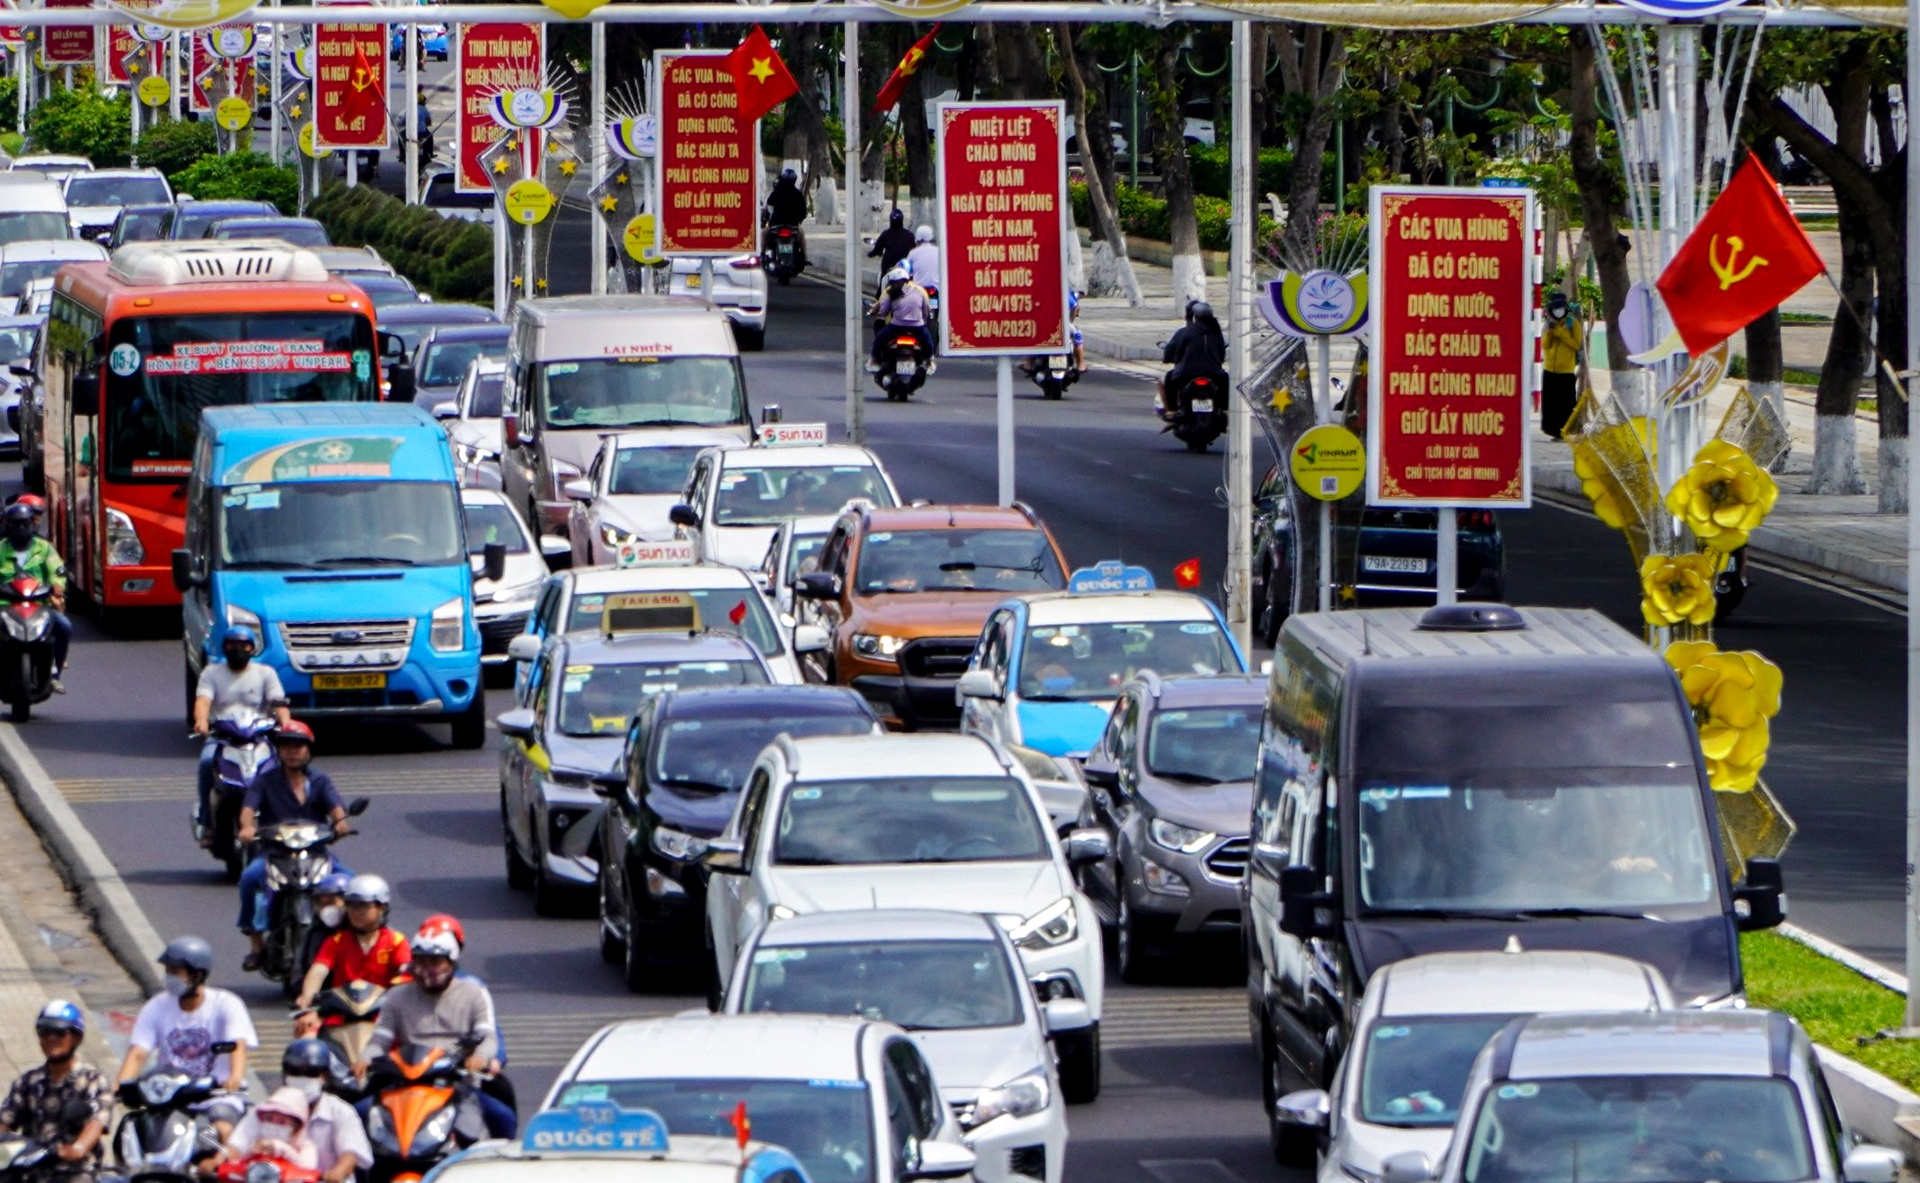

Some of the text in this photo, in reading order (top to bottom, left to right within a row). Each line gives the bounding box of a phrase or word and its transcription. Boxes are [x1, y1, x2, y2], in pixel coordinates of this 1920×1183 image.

[672, 66, 693, 84] CÁC
[694, 68, 714, 84] VUA
[677, 90, 738, 109] ĐÃ CÓ CÔNG
[970, 115, 1032, 141] NHIỆT LIỆT
[676, 141, 740, 159] BÁC CHÁU TA
[966, 141, 1036, 162] CHÀO MỪNG
[722, 168, 750, 184] NHAU
[979, 166, 1025, 187] 48 NĂM
[951, 189, 1054, 213] NGÀY GIẢI PHÓNG
[972, 215, 1038, 239] MIỀN NAM,
[1400, 212, 1510, 241] CÁC VUA HÙNG
[967, 240, 1040, 263] THỐNG NHẤT
[1408, 251, 1500, 280] ĐÃ CÓ CÔNG
[975, 266, 1033, 288] ĐẤT NƯỚC
[969, 295, 1034, 314] (30/4/1975
[1407, 291, 1500, 323] DỰNG NƯỚC,
[973, 320, 1037, 338] 30/4/2023)
[1405, 328, 1502, 358] BÁC CHÁU TA
[1389, 365, 1517, 397] PHẢI CÙNG NHAU
[1401, 404, 1504, 436] GIỮ LẤY NƯỚC
[801, 430, 823, 440] TAXI
[665, 548, 691, 559] TAXI
[533, 1124, 657, 1148] QUỐC TẾ
